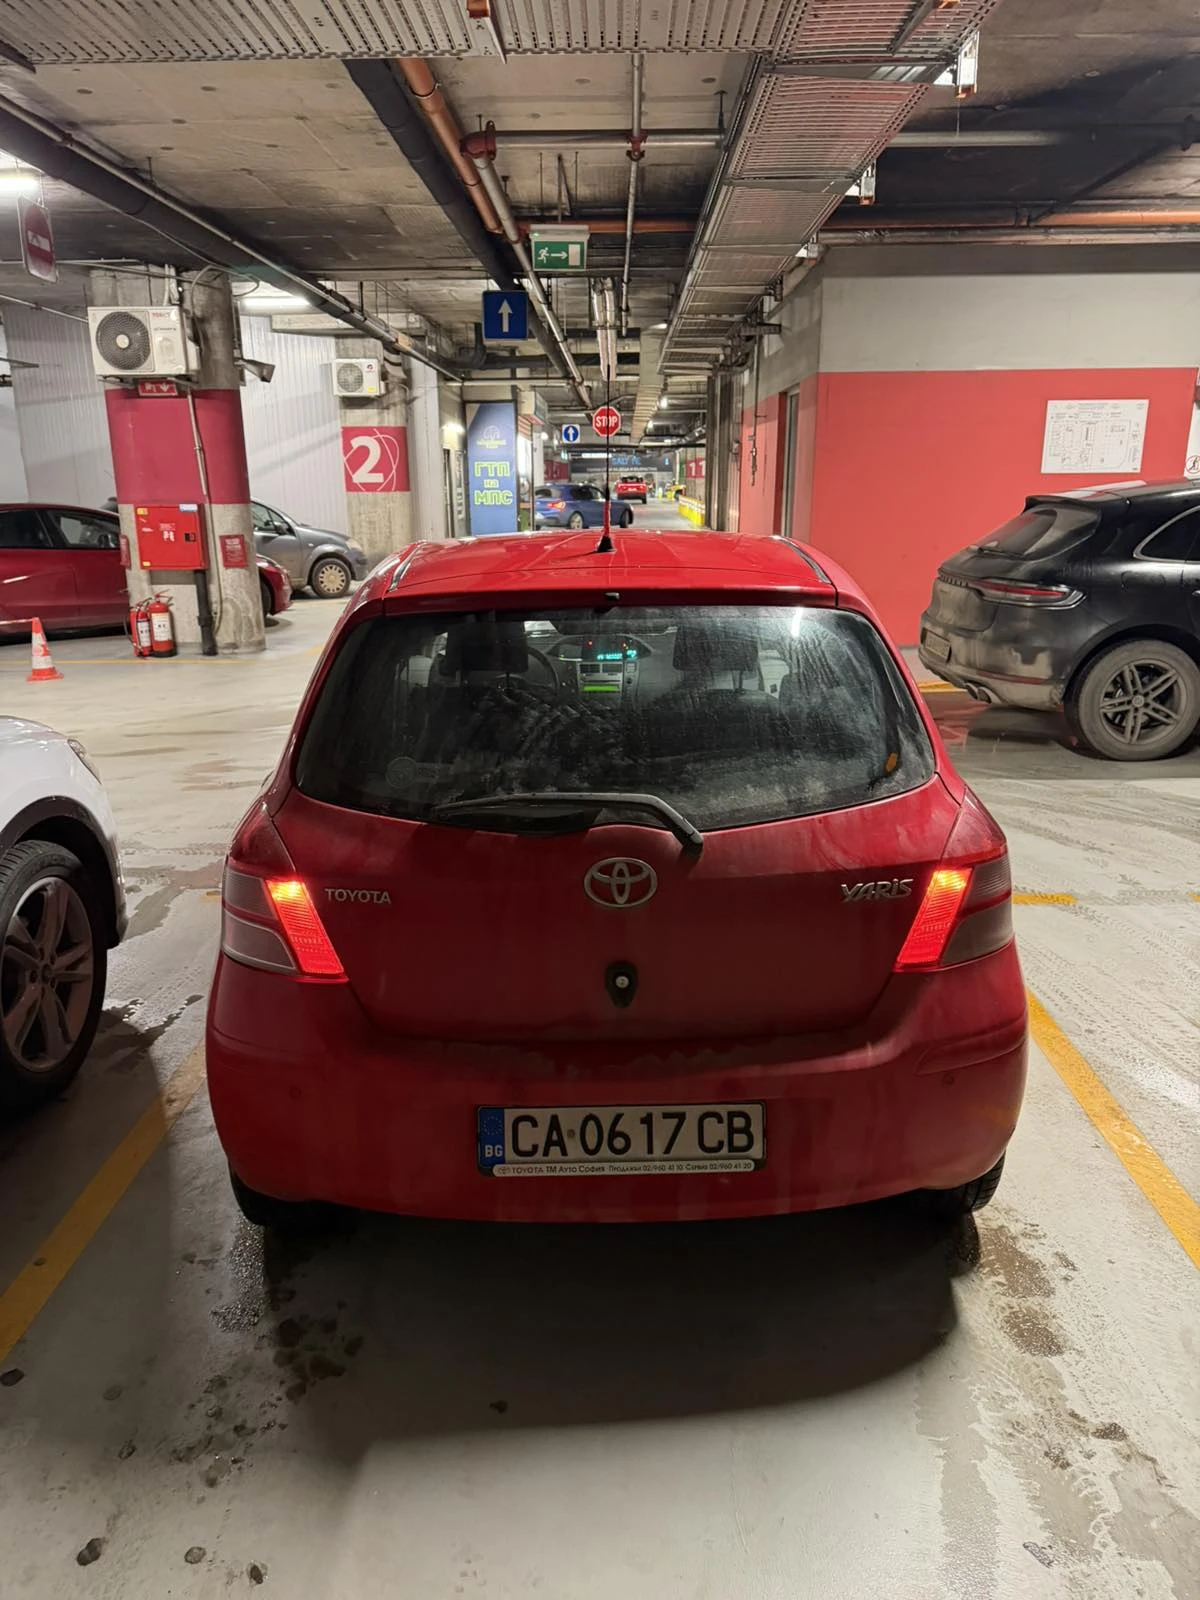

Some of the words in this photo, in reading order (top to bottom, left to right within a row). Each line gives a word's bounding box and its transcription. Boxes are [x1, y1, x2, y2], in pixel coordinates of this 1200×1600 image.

[595, 415, 618, 428] STOP
[350, 436, 385, 483] 2
[474, 461, 510, 477] ГТП
[474, 490, 513, 505] МПС
[324, 888, 392, 905] TOYOTA
[580, 1111, 687, 1157] 0617
[484, 1144, 504, 1158] BG
[512, 1166, 544, 1175] TOYOTA
